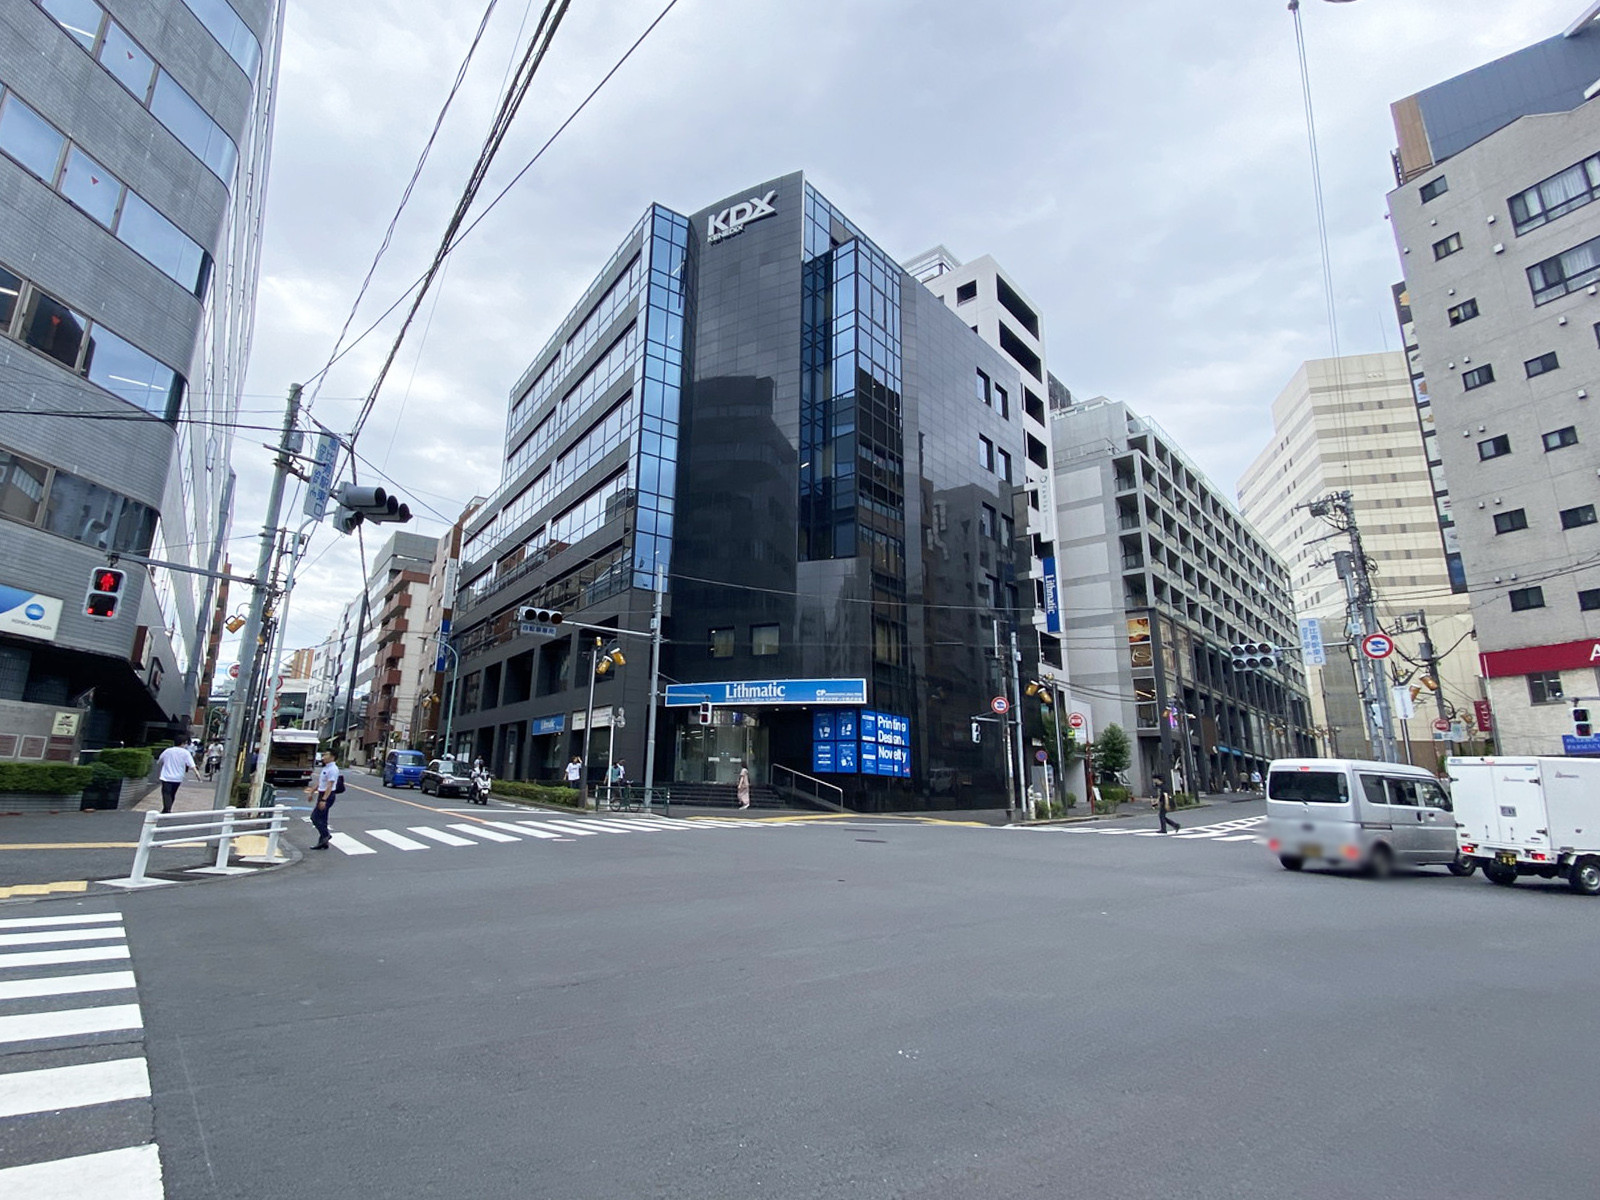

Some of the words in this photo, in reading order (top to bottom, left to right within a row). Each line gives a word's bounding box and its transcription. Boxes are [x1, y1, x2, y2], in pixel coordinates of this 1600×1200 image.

[708, 190, 776, 236] KDX
[1045, 574, 1056, 615] Lithmatic
[726, 682, 786, 698] Lithmatic
[878, 715, 906, 732] Printing
[878, 746, 906, 763] Novelty
